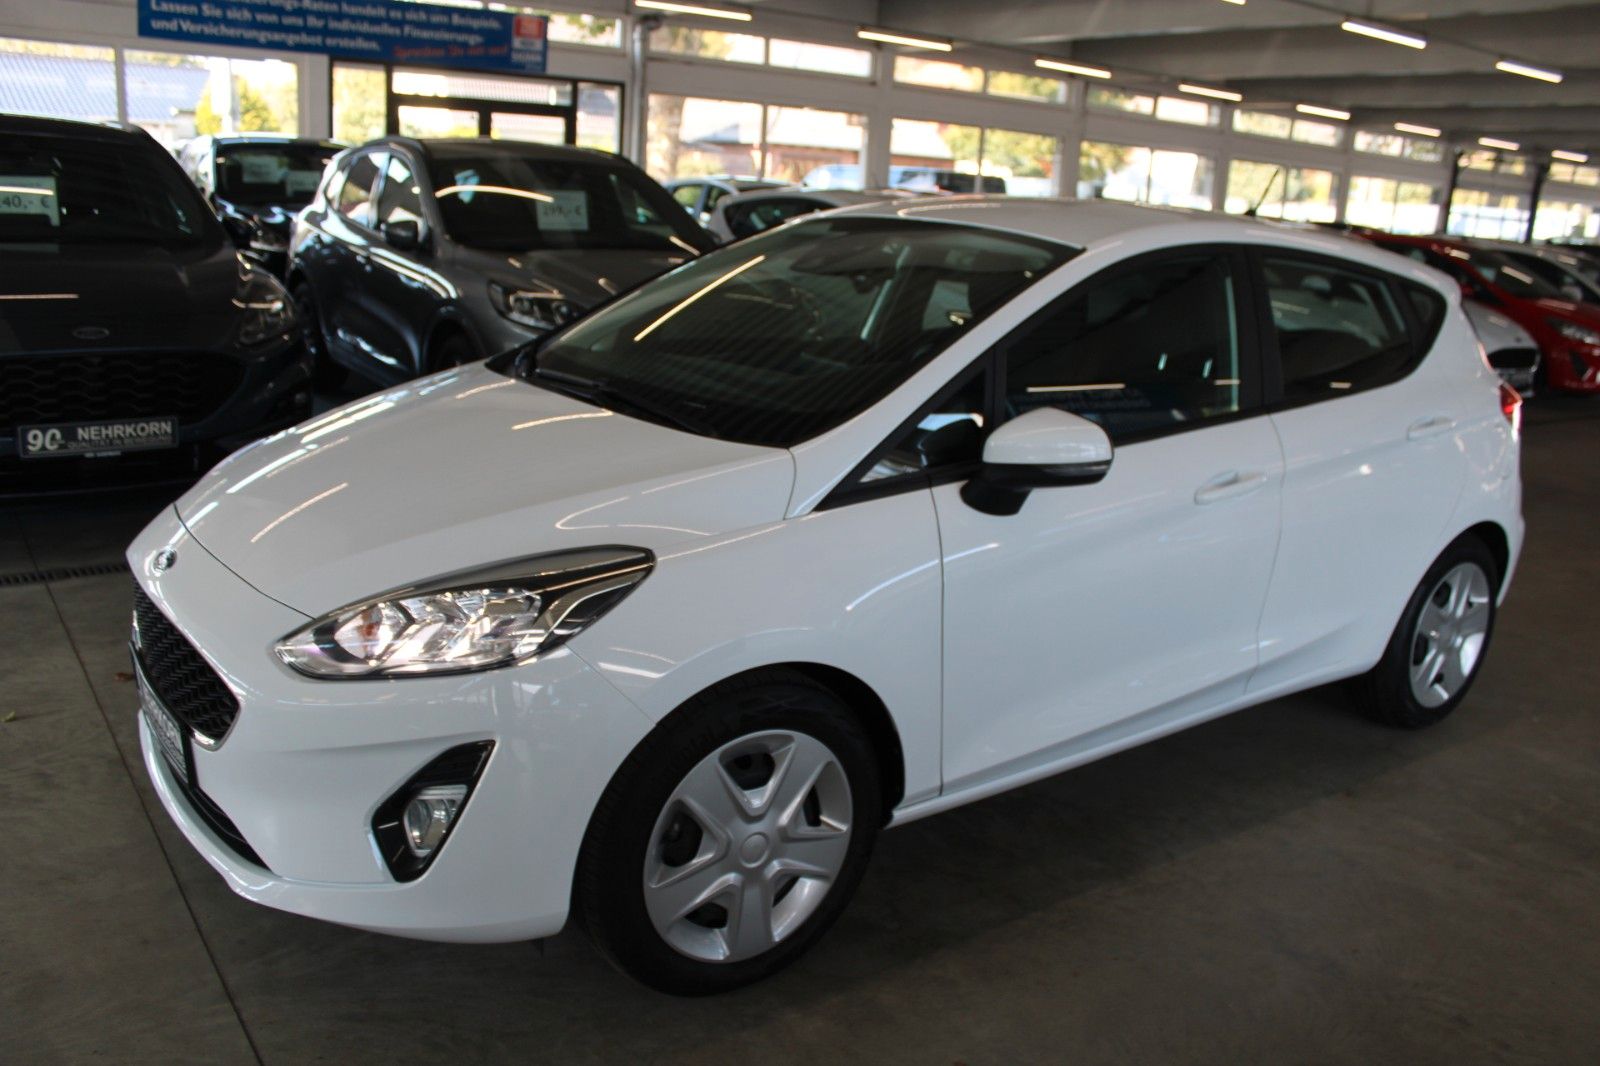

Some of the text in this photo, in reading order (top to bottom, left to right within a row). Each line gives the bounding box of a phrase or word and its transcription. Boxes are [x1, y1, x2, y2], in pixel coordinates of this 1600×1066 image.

[150, 18, 179, 33] und
[201, 3, 224, 19] Sie
[226, 7, 253, 22] sich
[254, 12, 280, 25] von
[281, 15, 304, 27] uns
[306, 14, 326, 29] Ihr
[77, 420, 173, 442] NEHRKORN
